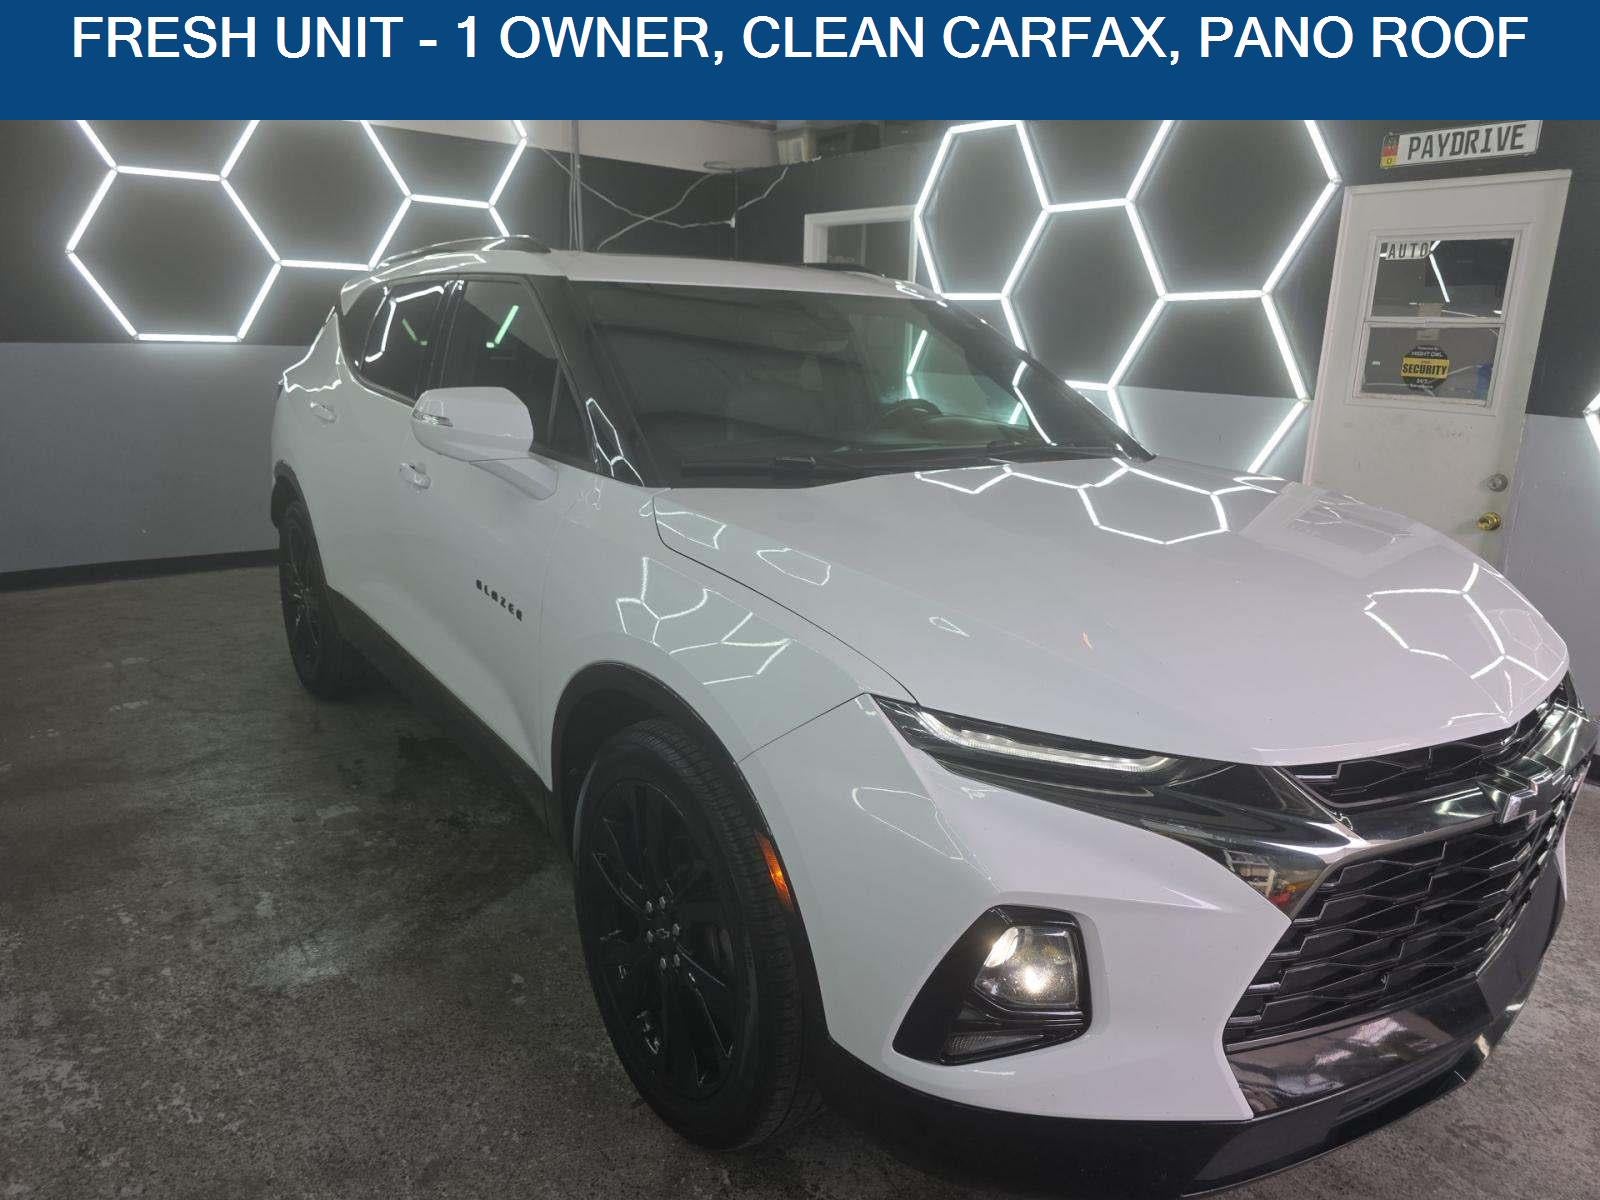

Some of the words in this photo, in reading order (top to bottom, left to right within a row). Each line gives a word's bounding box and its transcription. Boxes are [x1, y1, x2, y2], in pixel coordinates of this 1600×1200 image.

[1407, 123, 1527, 160] PAYDRIVE
[1388, 242, 1429, 259] AUTO
[1402, 363, 1448, 376] SECURITY
[475, 579, 523, 622] BLAZER
